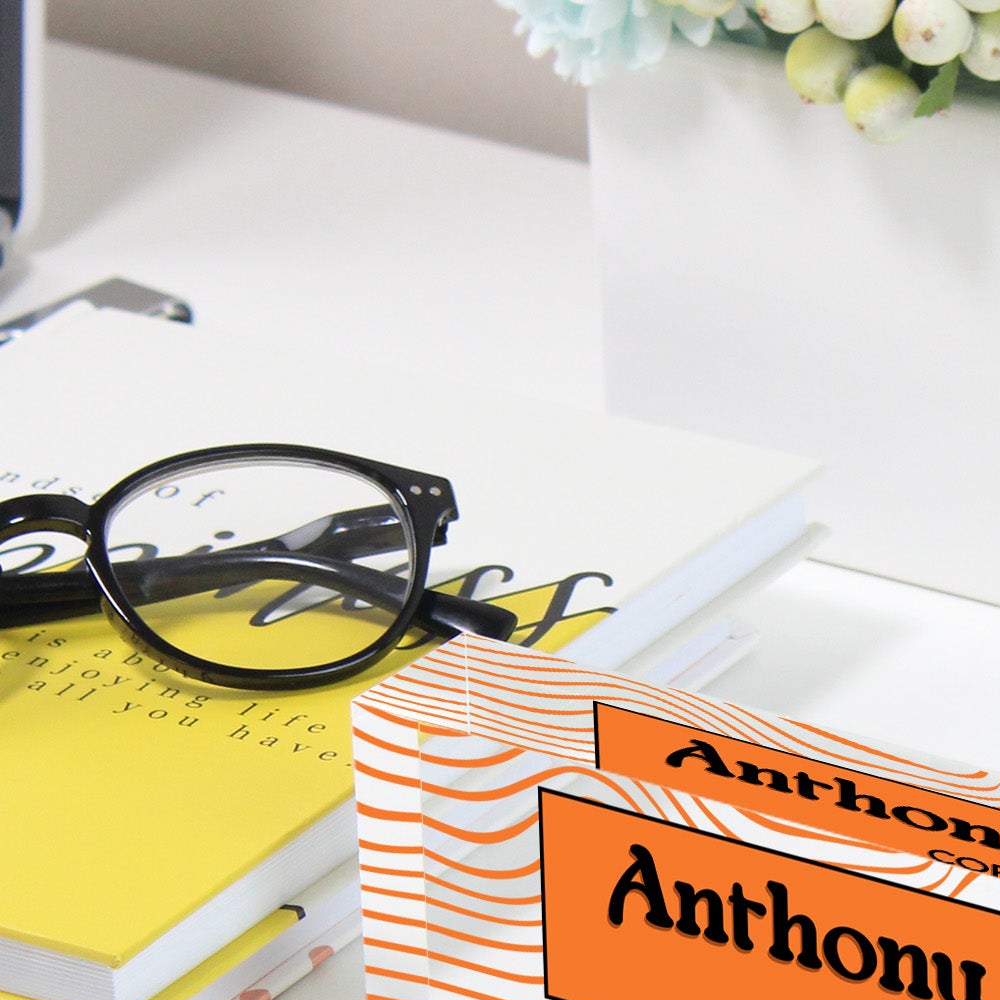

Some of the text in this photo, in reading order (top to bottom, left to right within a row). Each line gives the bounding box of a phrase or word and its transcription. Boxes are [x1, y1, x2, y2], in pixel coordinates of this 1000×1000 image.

[154, 484, 226, 508] of
[27, 629, 67, 648] is
[1, 650, 327, 735] enjoying life
[27, 680, 97, 701] all
[112, 700, 201, 728] you
